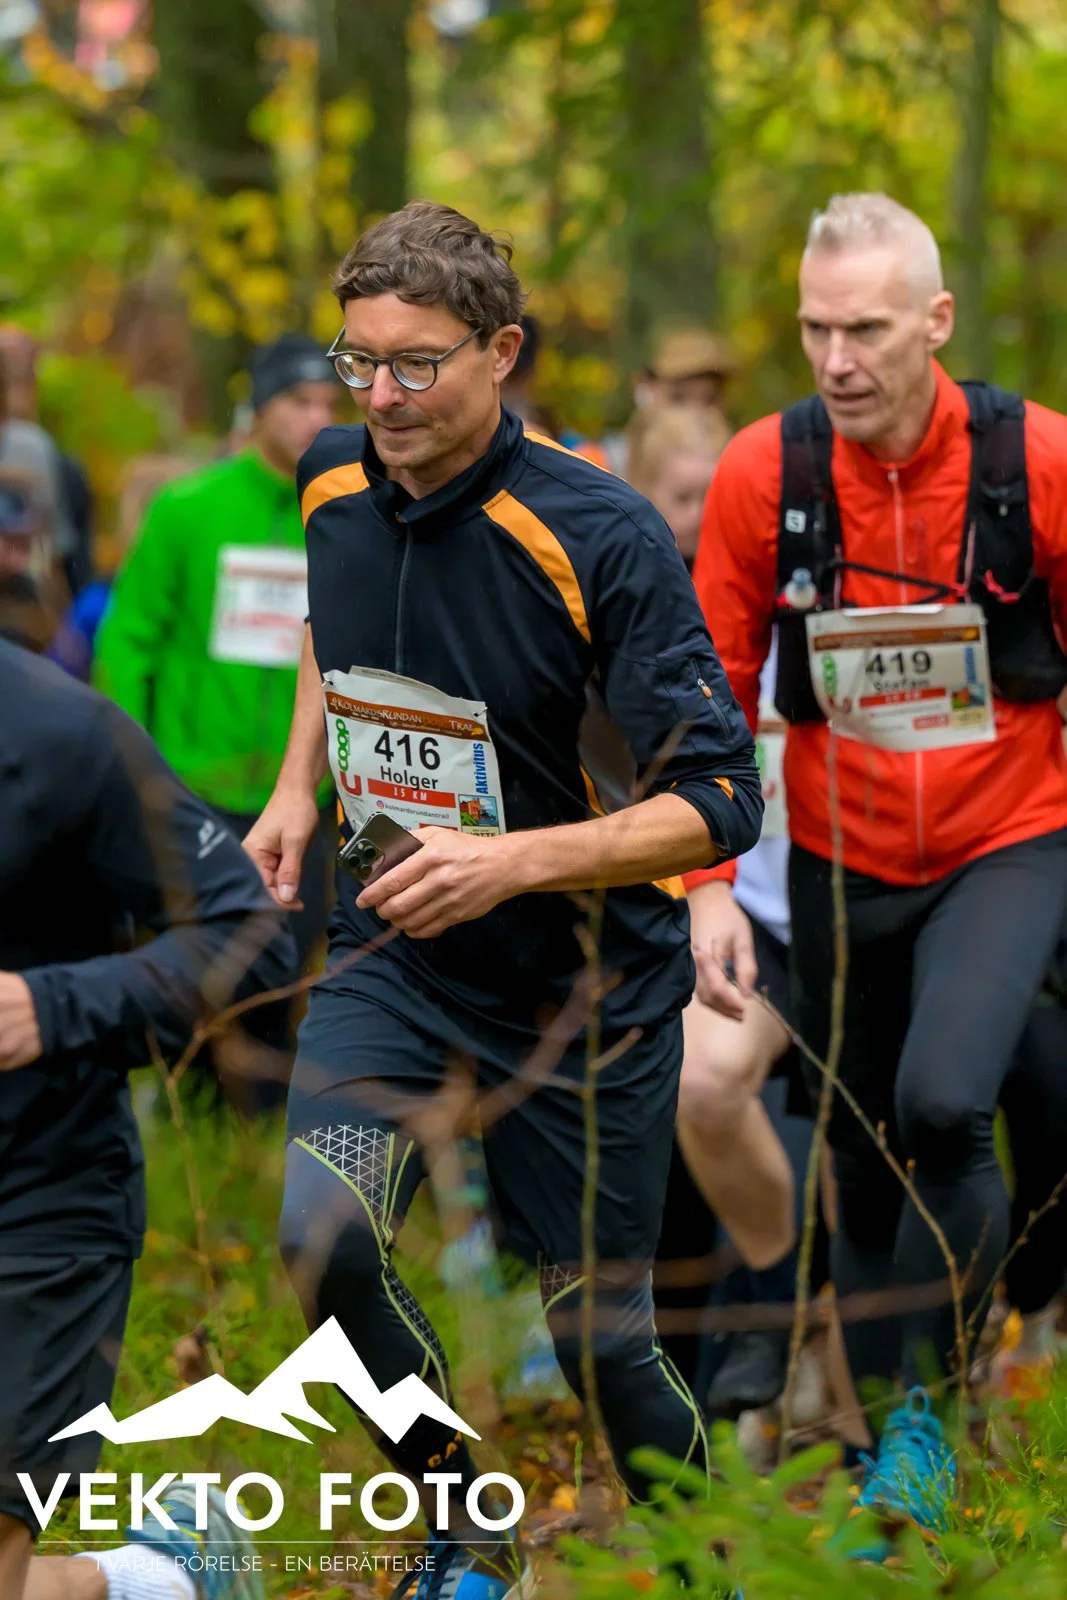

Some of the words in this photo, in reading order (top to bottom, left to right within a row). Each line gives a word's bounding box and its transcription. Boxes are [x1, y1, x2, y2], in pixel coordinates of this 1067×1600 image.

[865, 651, 931, 675] 419
[374, 730, 441, 771] 416
[380, 765, 439, 790] Holger
[473, 743, 489, 794] Aktivitus
[393, 787, 406, 798] 15
[412, 791, 427, 801] KM
